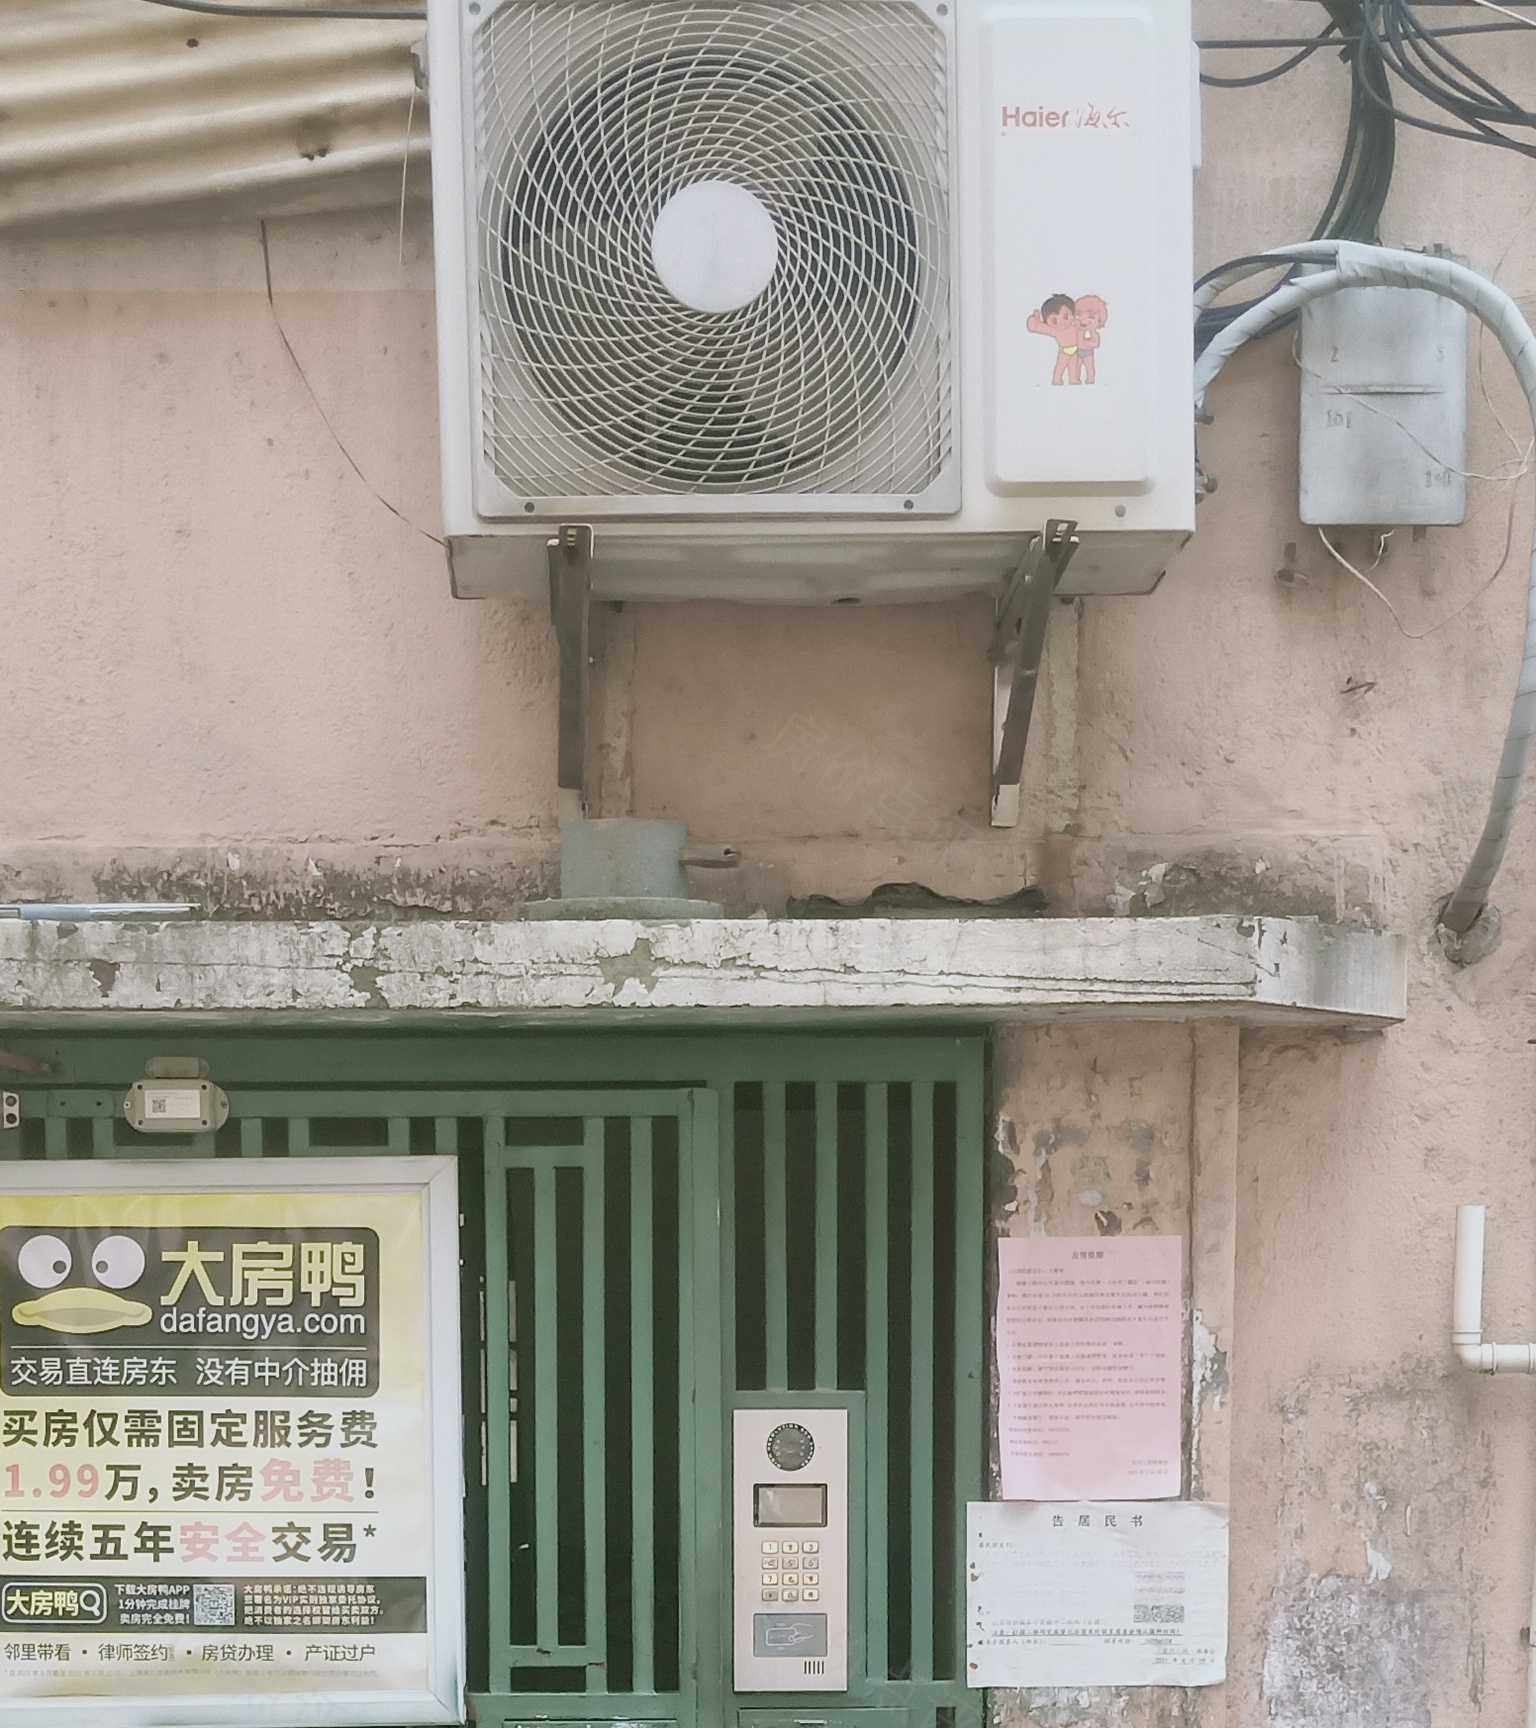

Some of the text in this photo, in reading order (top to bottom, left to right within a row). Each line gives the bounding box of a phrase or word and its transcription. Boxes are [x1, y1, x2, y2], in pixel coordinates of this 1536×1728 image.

[1002, 105, 1070, 128] Haier
[160, 1240, 366, 1307] 大房鸭
[160, 1306, 367, 1340] dafangya.com
[10, 1357, 368, 1388] 交易直连房东 没有中介抽佣
[2, 1408, 379, 1449] 买房仅需固定服务费
[1051, 1514, 1145, 1528] 告居民书
[5, 1588, 80, 1618] 大房鸭
[114, 1584, 191, 1596] 下载大房鸭APP
[3, 1642, 376, 1662] 邻里带看 律师签约 房贷办理 产证过户
